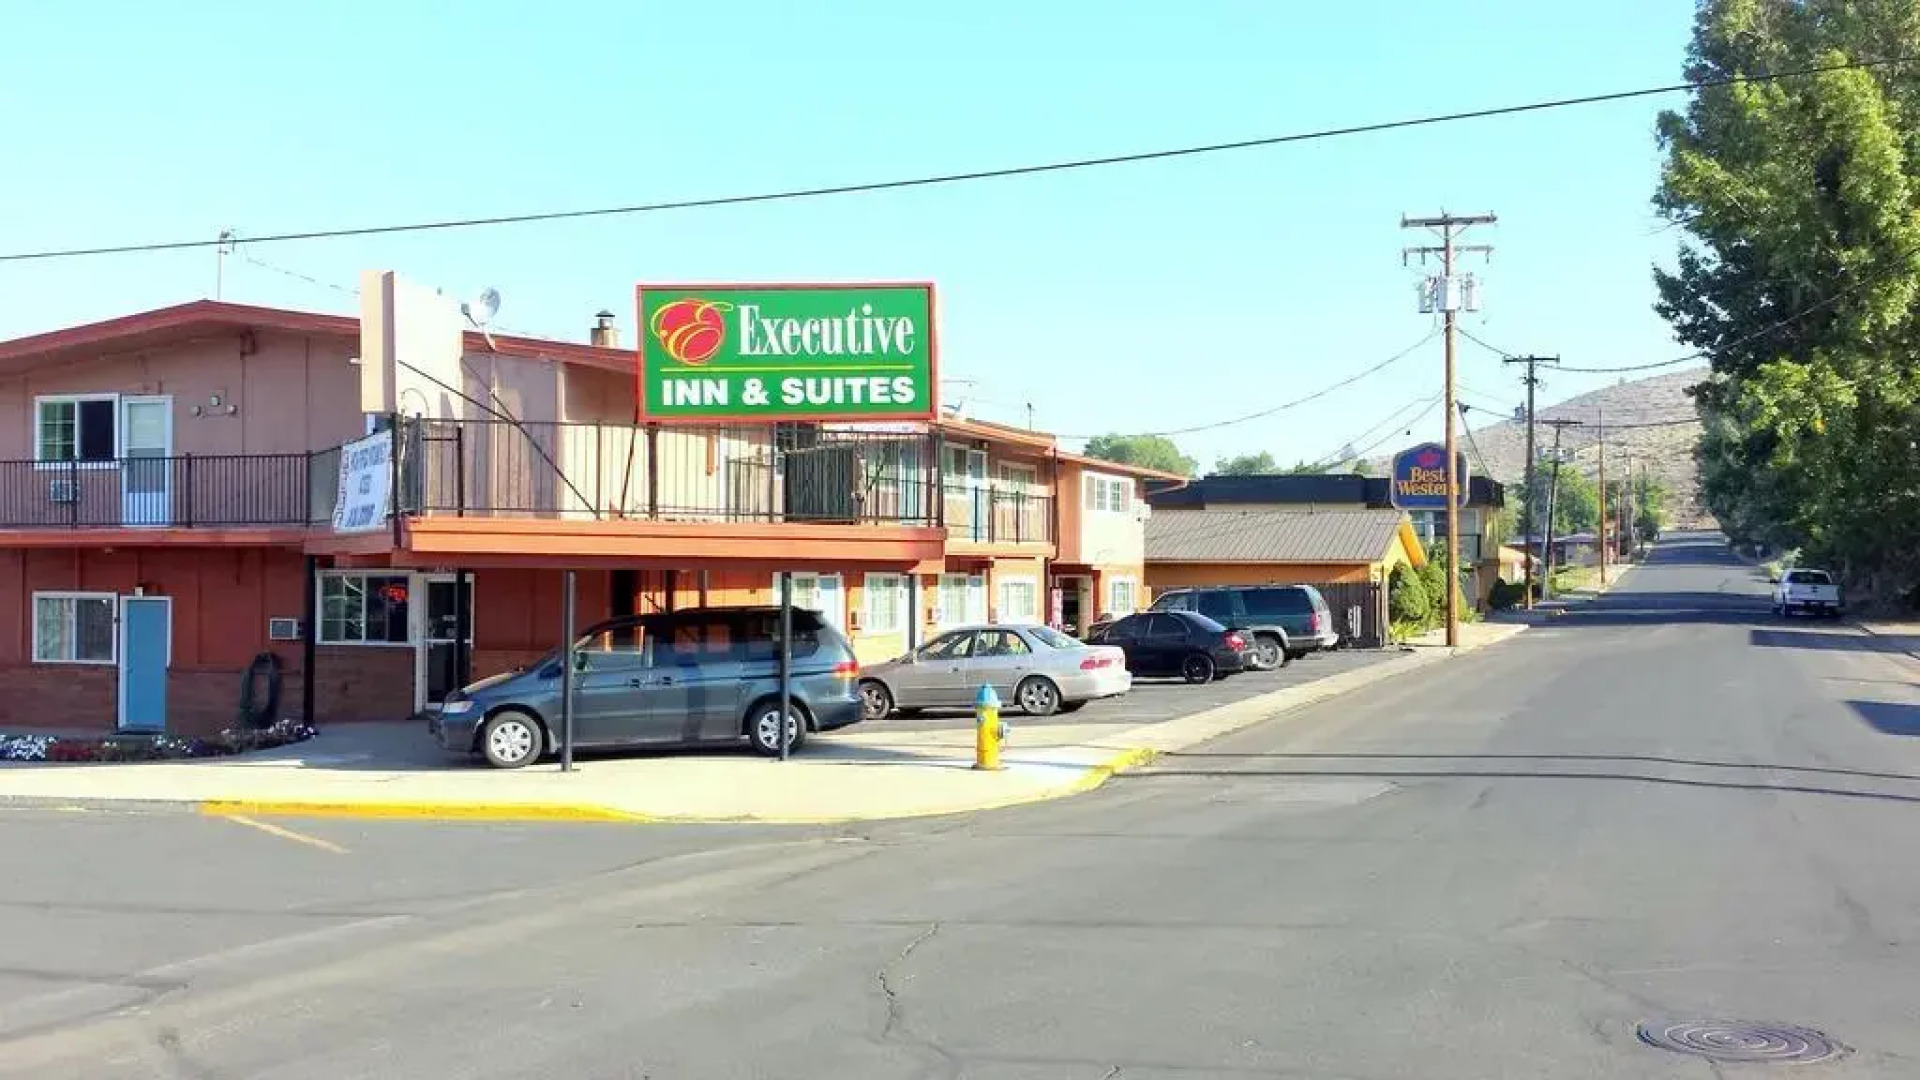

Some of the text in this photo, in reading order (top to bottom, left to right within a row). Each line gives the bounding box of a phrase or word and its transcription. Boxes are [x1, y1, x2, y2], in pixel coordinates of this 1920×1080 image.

[737, 303, 915, 356] Executive
[661, 376, 916, 406] INN & SUITES
[1410, 467, 1446, 482] Best
